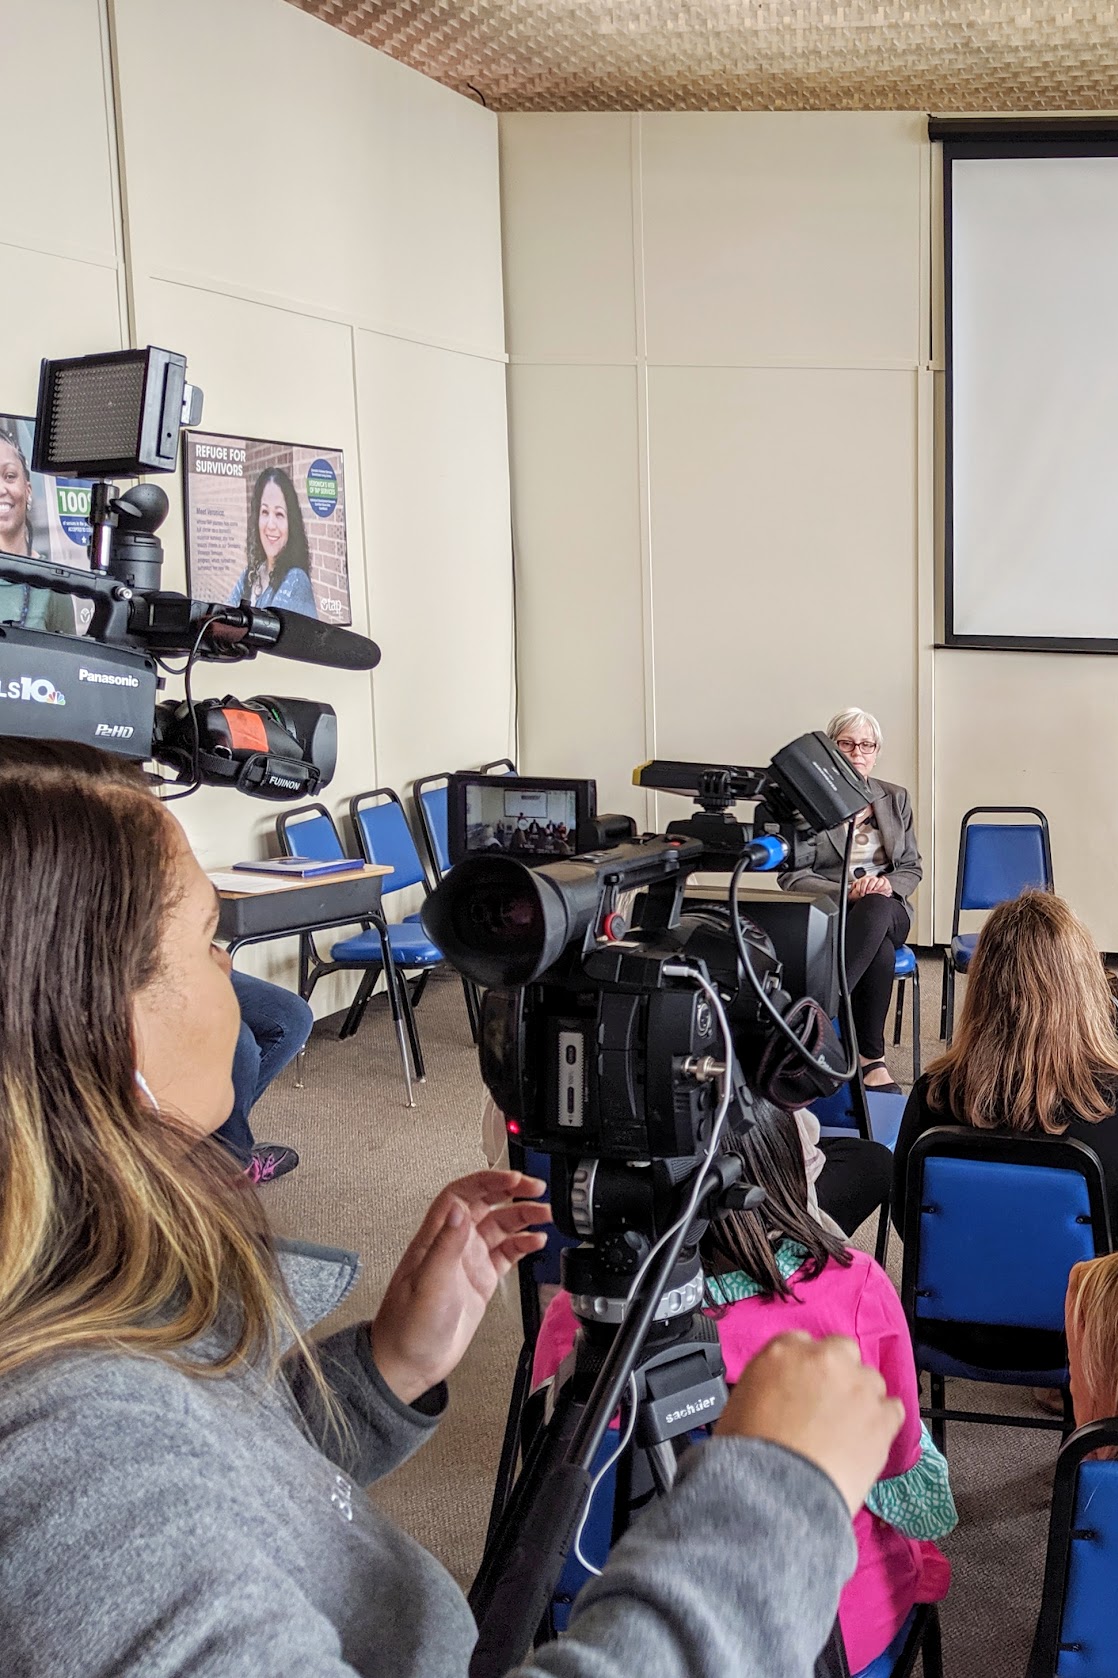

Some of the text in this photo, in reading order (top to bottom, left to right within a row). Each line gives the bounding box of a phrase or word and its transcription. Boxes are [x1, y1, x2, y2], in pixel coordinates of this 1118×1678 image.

[195, 444, 246, 462] REFUGE FOR
[195, 459, 243, 477] SURVIVORS
[78, 668, 139, 688] Panasonic
[95, 723, 135, 739] P2HD
[269, 776, 301, 791] FUJINON
